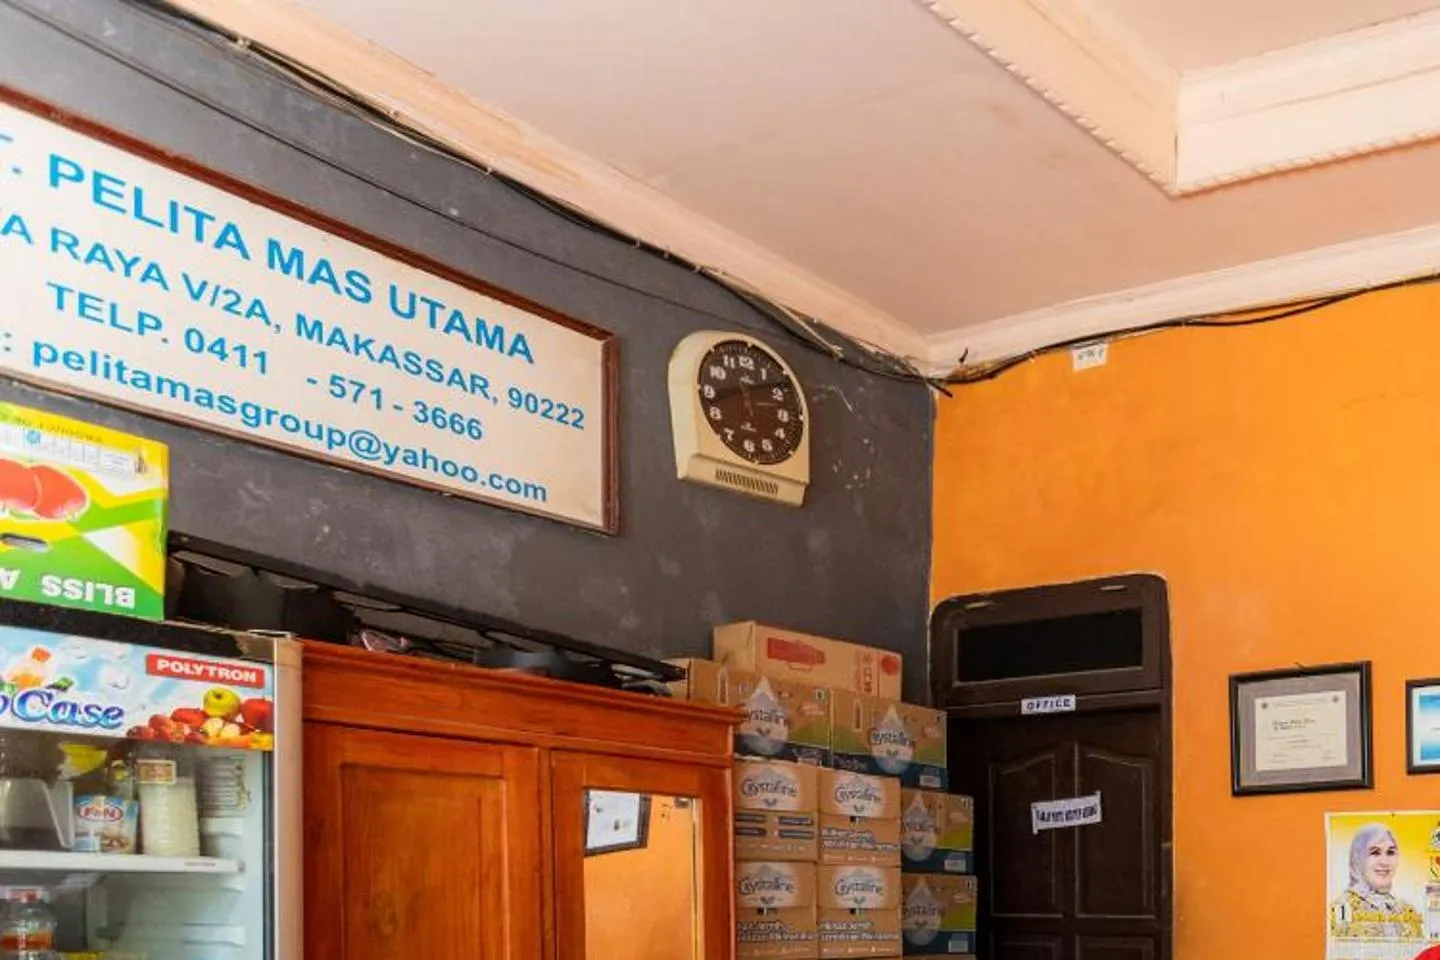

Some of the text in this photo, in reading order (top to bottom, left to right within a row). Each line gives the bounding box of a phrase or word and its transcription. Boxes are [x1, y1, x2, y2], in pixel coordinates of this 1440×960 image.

[47, 152, 250, 260] PELITA
[266, 238, 372, 304] MAS
[389, 283, 536, 364] UTAMA
[46, 281, 169, 344] TELP.
[184, 327, 269, 375] 0411
[50, 226, 169, 290] RAYA
[182, 272, 282, 333] V/2A,
[295, 312, 499, 405] MAKASSAR,
[507, 386, 586, 431] 90222
[31, 339, 548, 502] pelitamasgroup@yahoo.com
[41, 574, 136, 609] BLISS
[156, 657, 257, 683] POLYTRON
[1026, 698, 1071, 710] OFFICE
